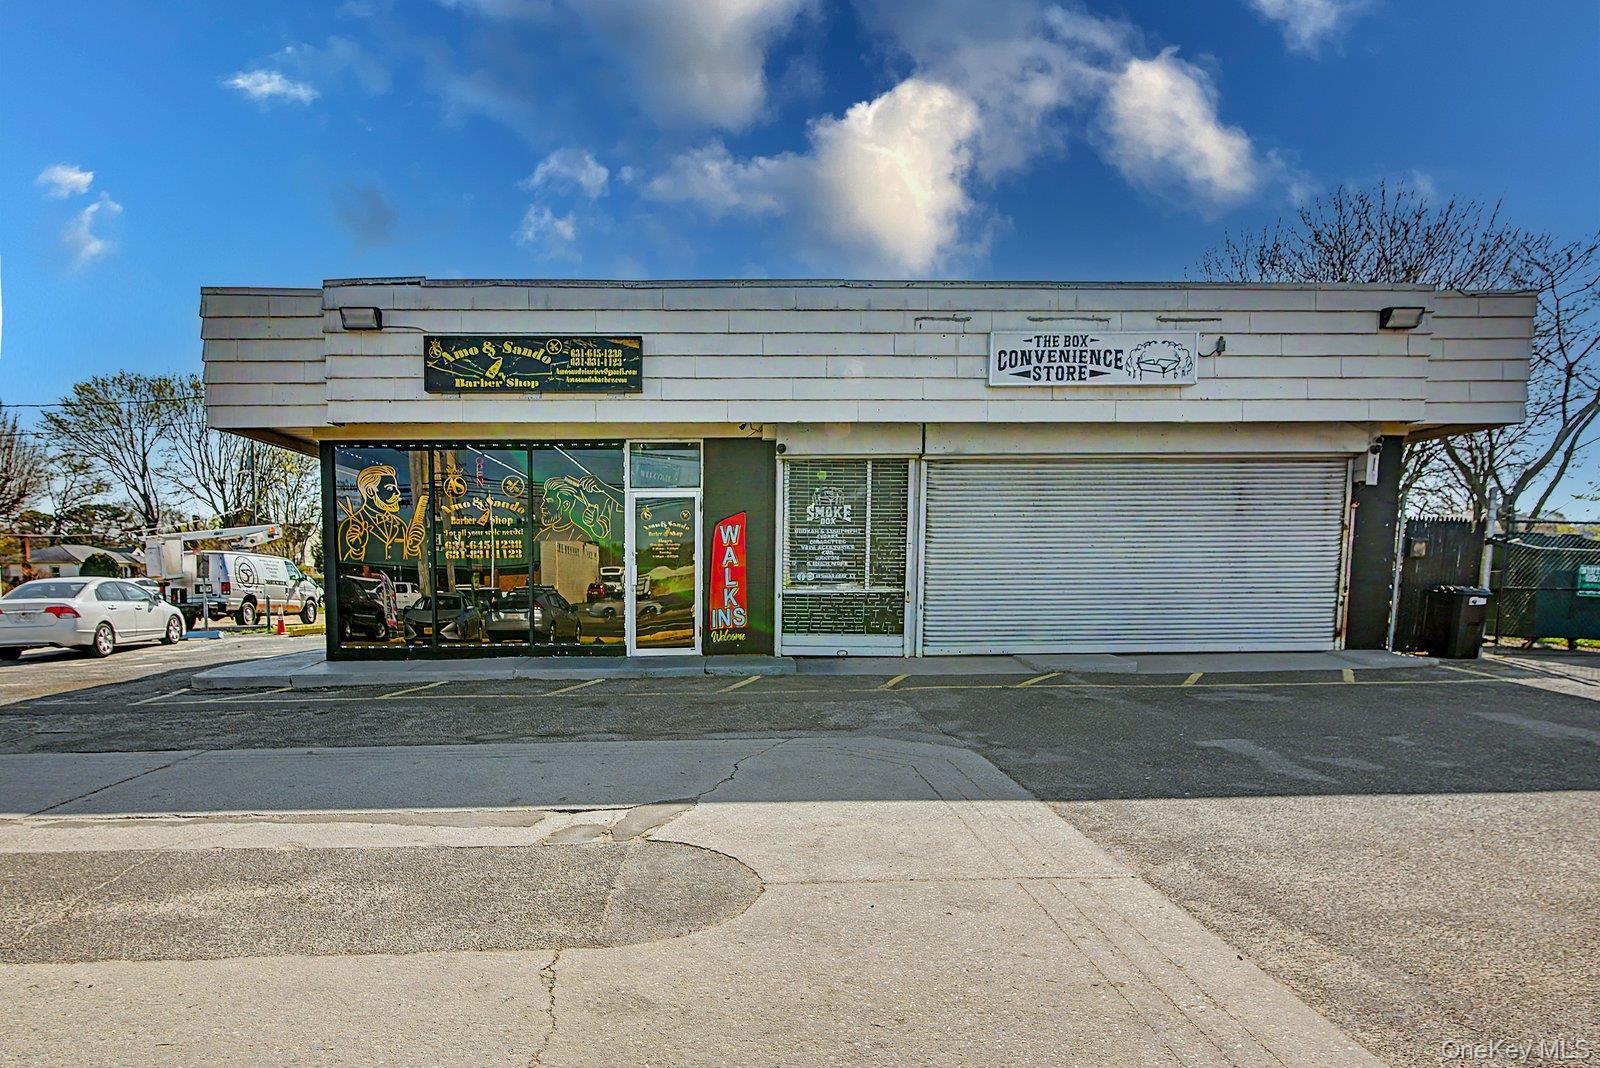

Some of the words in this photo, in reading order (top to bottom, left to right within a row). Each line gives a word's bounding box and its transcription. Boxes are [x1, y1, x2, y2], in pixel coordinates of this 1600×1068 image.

[1034, 335, 1059, 348] THE
[1063, 335, 1089, 348] BOX
[442, 346, 479, 365] Amo
[482, 341, 497, 357] &
[502, 341, 552, 364] Sando
[998, 349, 1124, 371] CONVENIENCE
[1032, 365, 1088, 382] STORE
[455, 378, 502, 388] Barber
[506, 378, 540, 388] Shop
[441, 501, 471, 514] Amo
[806, 505, 852, 522] SMOKE
[450, 516, 477, 525] Barber
[720, 524, 741, 608] WALK
[711, 607, 747, 629] INS
[711, 629, 746, 643] Welcome
